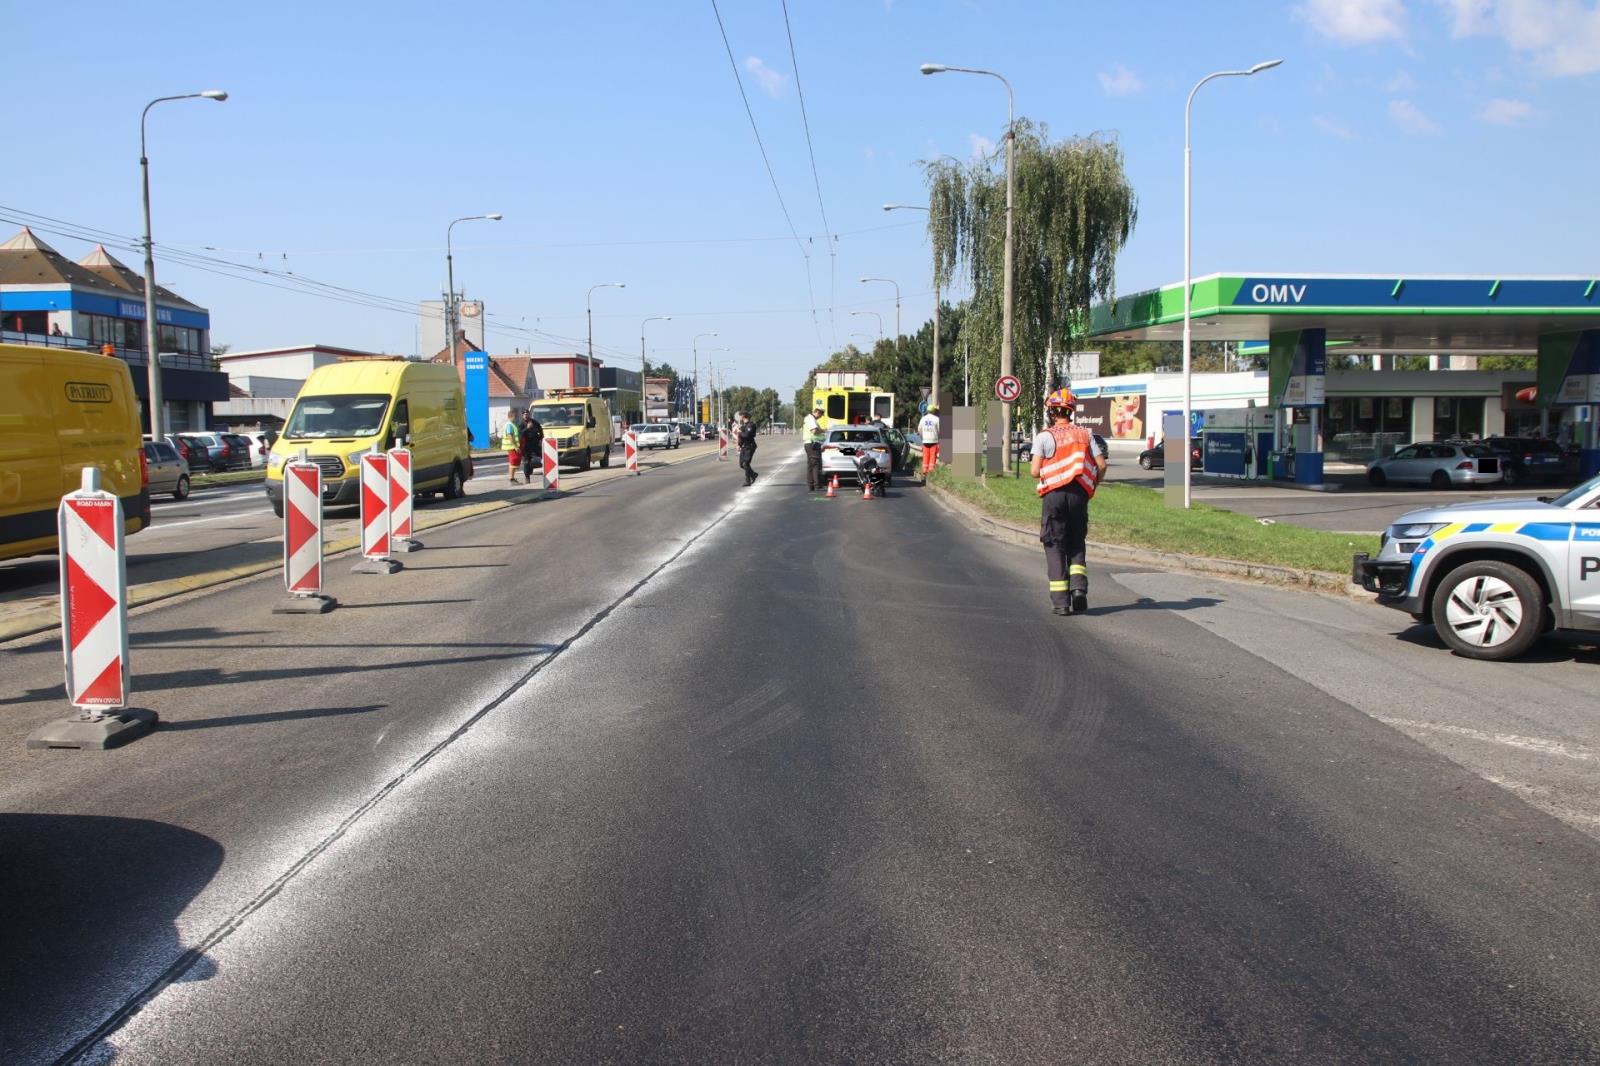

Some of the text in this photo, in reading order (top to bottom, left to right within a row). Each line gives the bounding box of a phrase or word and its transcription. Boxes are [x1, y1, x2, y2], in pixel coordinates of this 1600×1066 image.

[1252, 284, 1306, 303] OMV
[69, 385, 108, 400] PATRIOT
[1580, 556, 1600, 581] P
